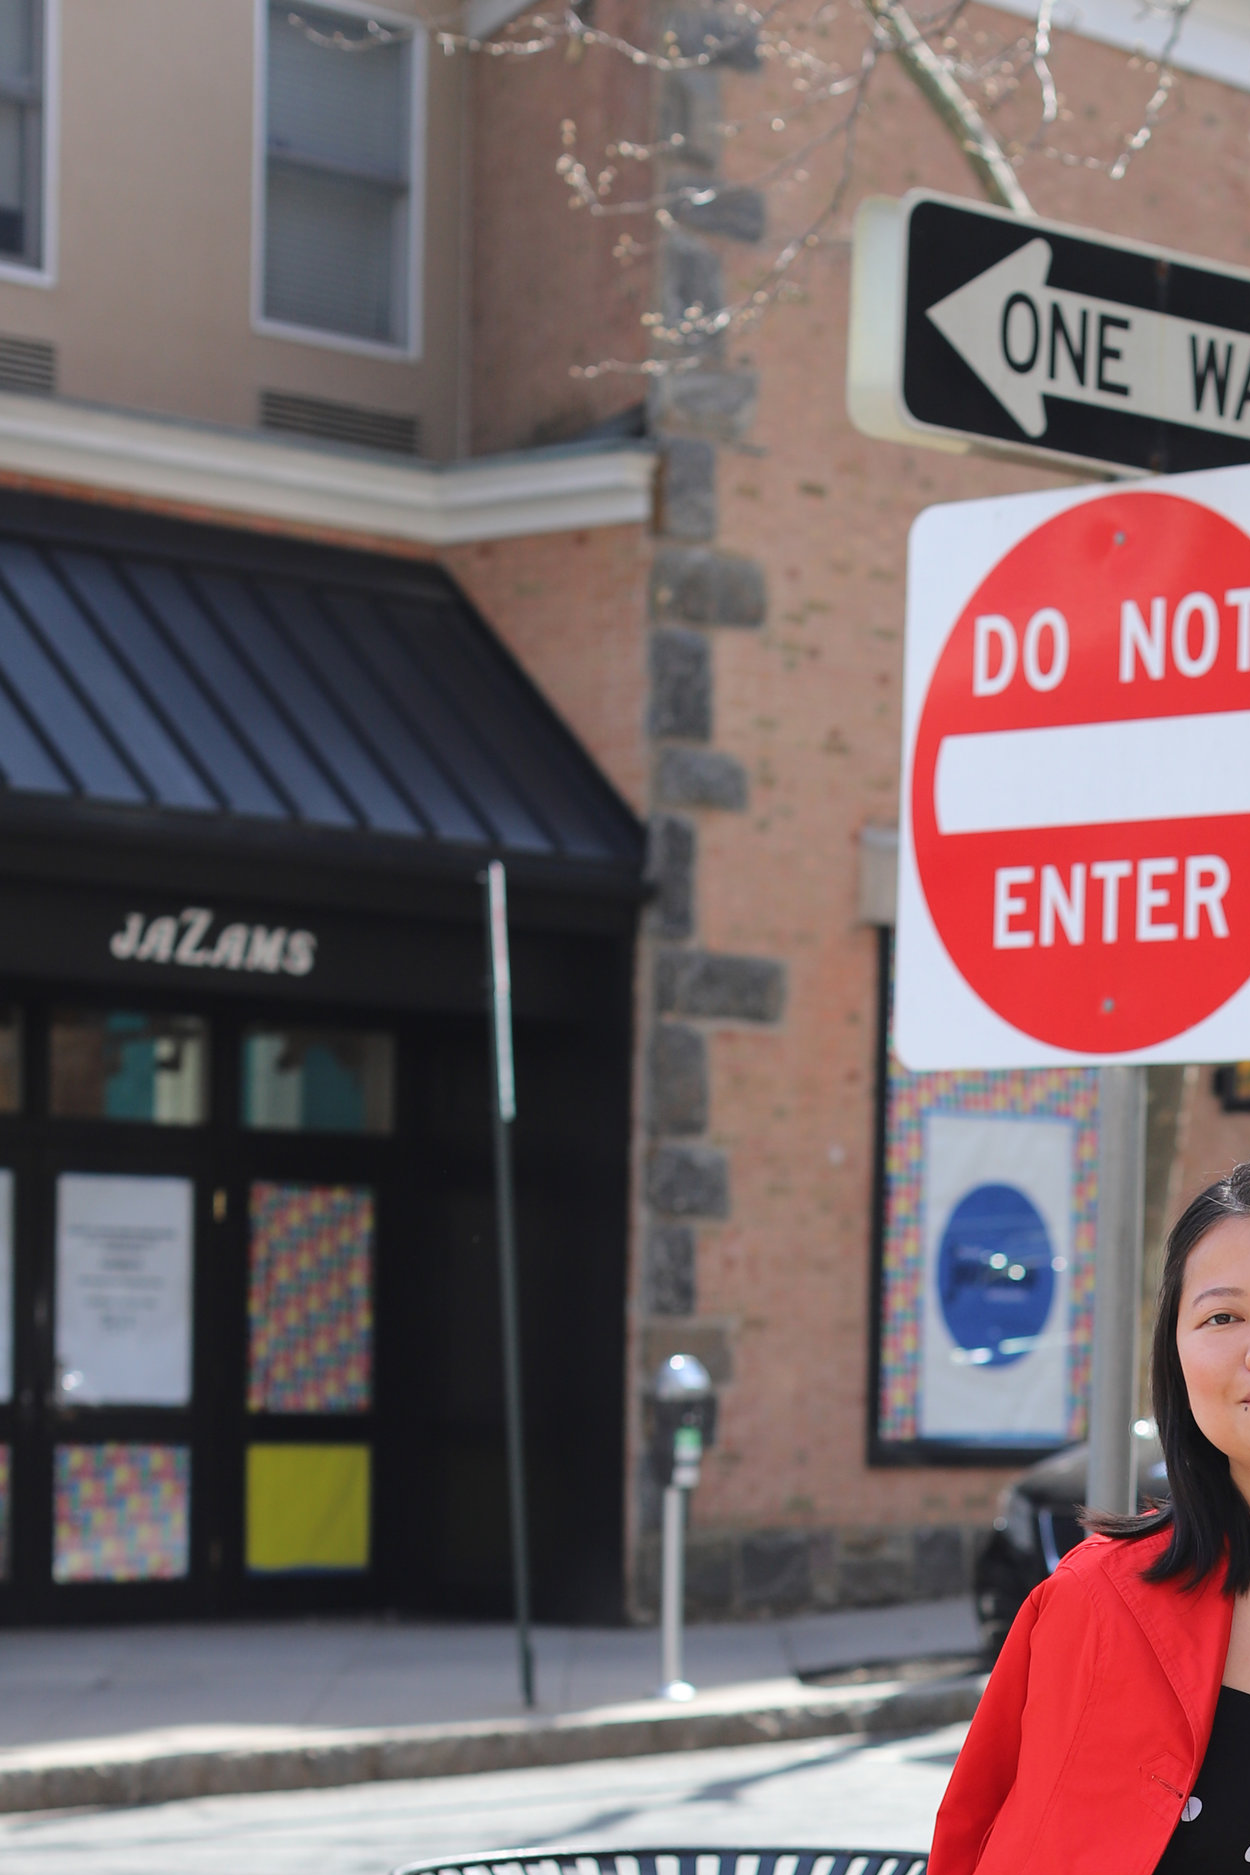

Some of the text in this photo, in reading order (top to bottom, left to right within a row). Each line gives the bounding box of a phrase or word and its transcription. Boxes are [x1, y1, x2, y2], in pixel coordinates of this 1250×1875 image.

[1001, 292, 1132, 398] ONE
[972, 606, 1070, 697] DO
[992, 854, 1231, 950] ENTER
